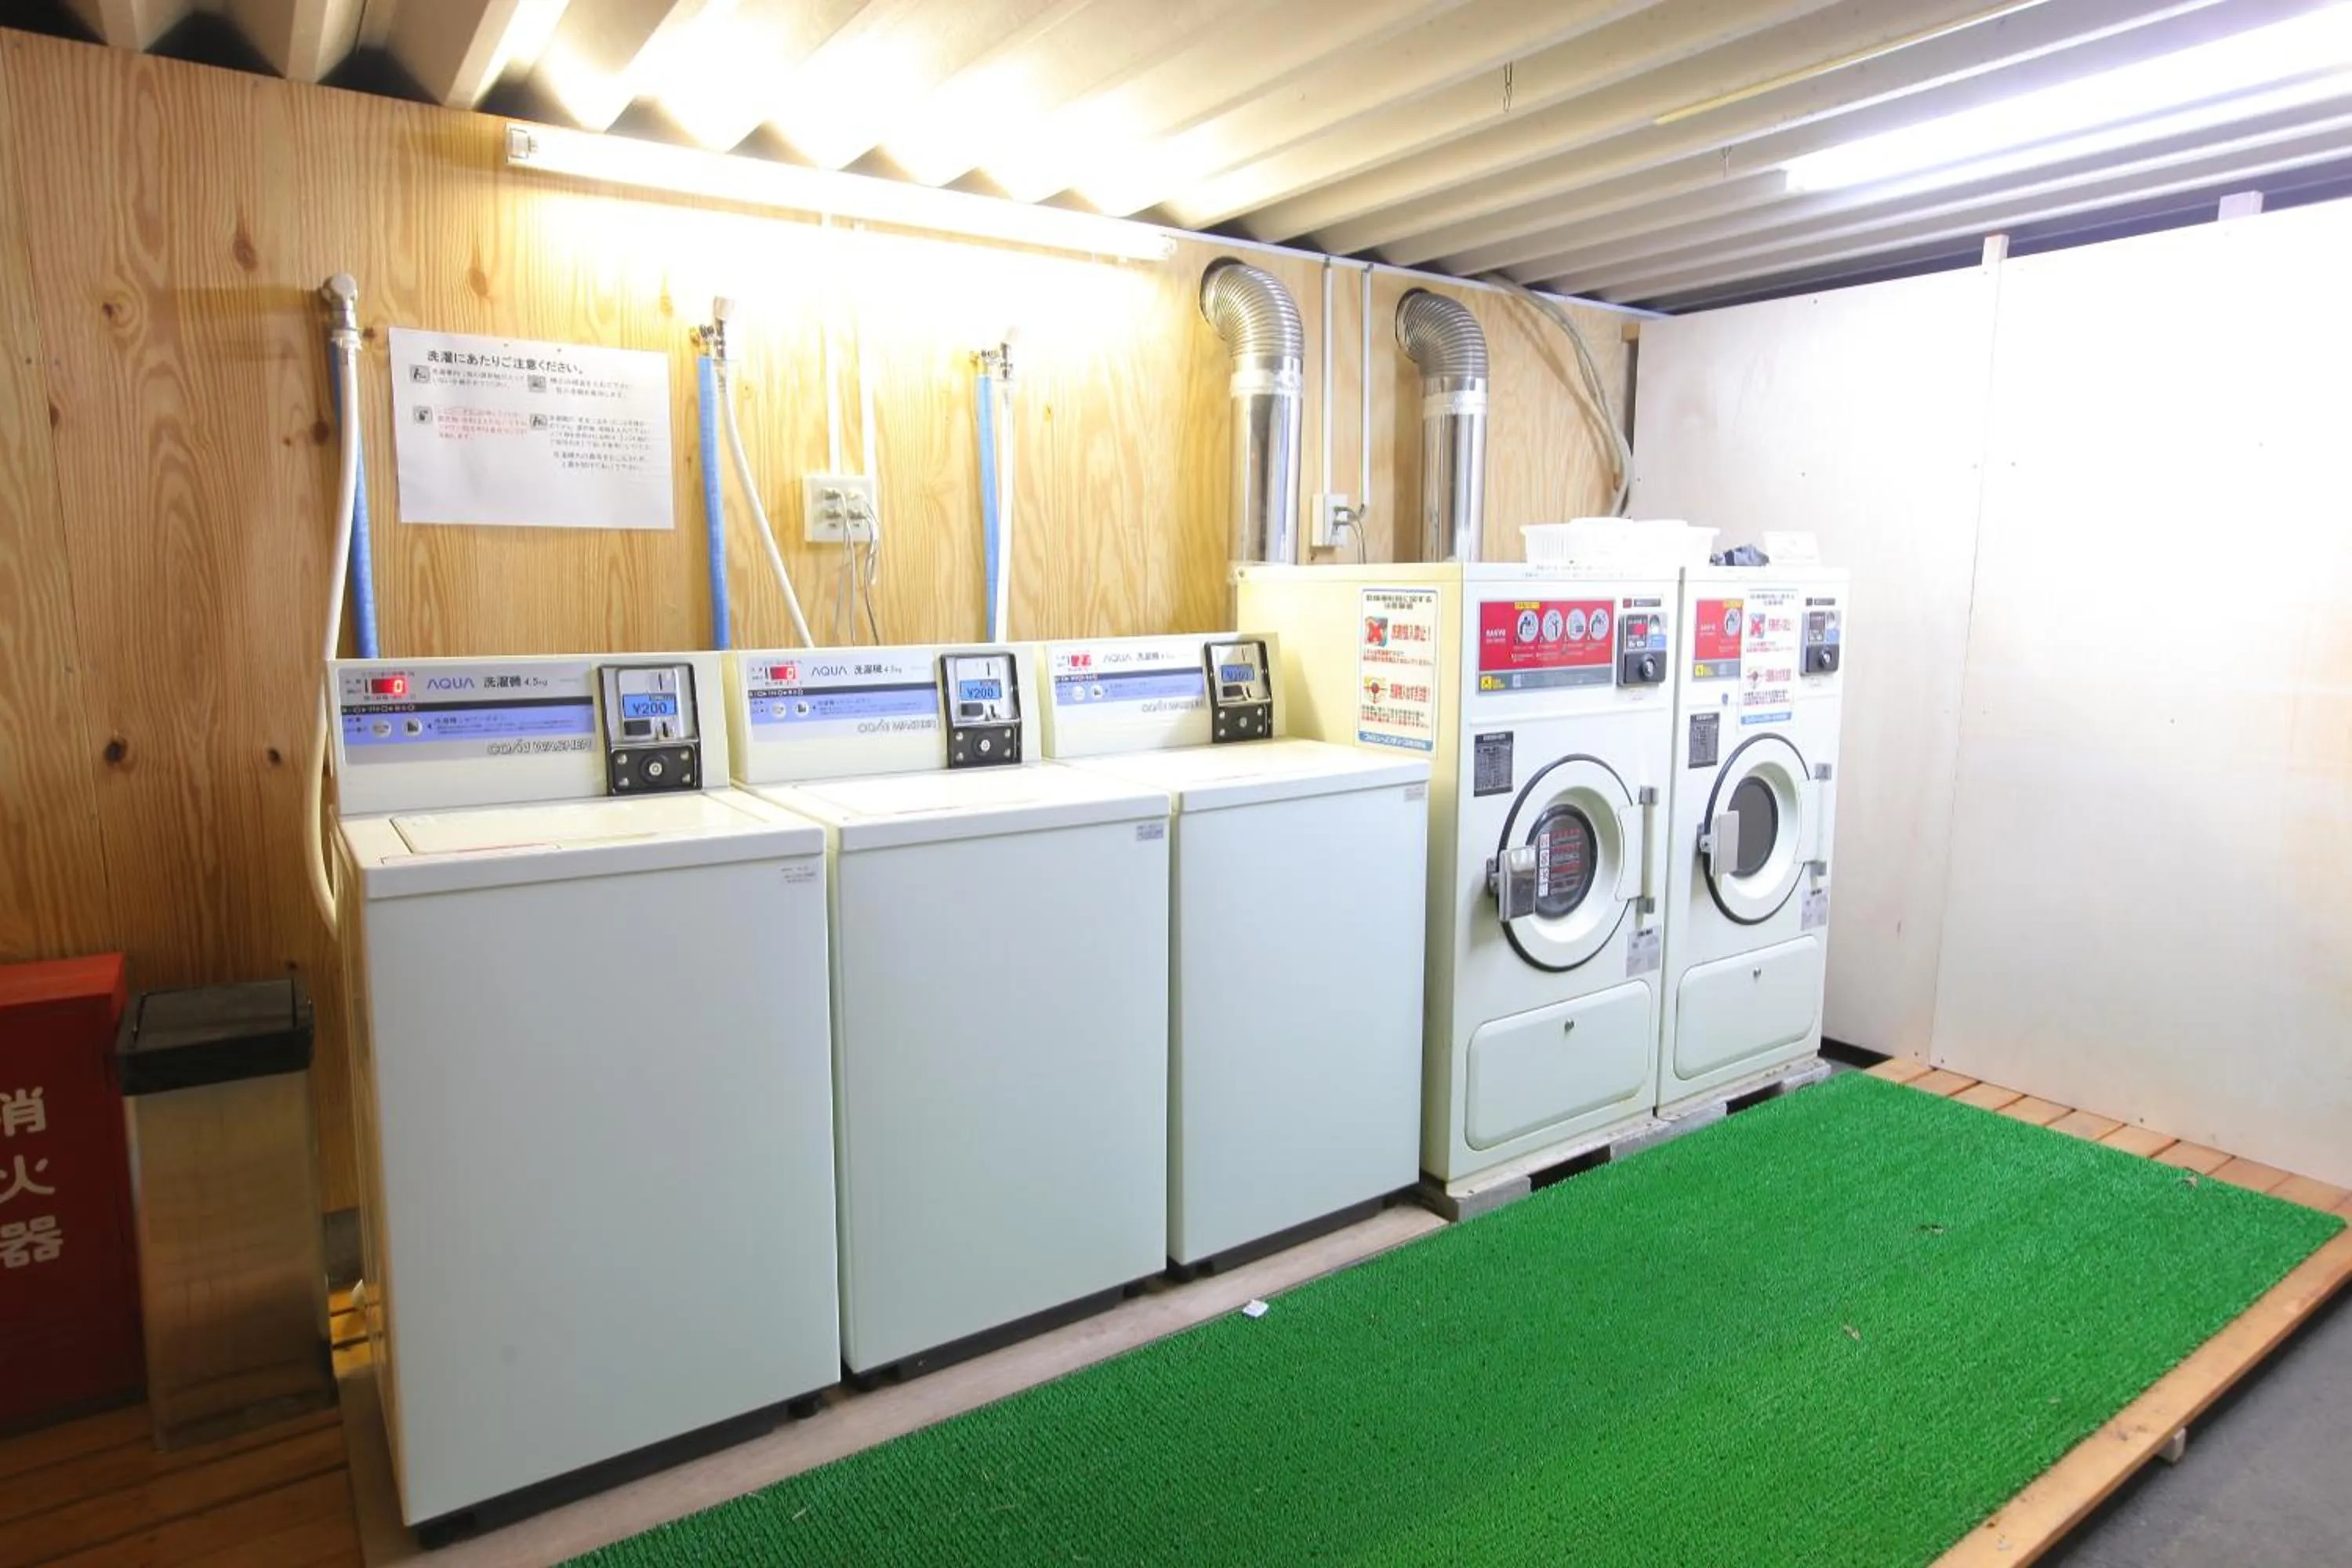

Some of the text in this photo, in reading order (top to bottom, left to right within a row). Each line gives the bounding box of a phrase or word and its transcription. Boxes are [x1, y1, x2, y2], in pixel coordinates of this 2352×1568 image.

[426, 350, 583, 375] 洗濯にあたりご注意ください。
[811, 665, 848, 677] AQUA
[854, 664, 882, 674] 洗濯機
[394, 679, 404, 692] 0
[427, 677, 475, 689] AQUA
[484, 675, 521, 688] 洗濯機
[0, 1086, 64, 1269] 消火器
